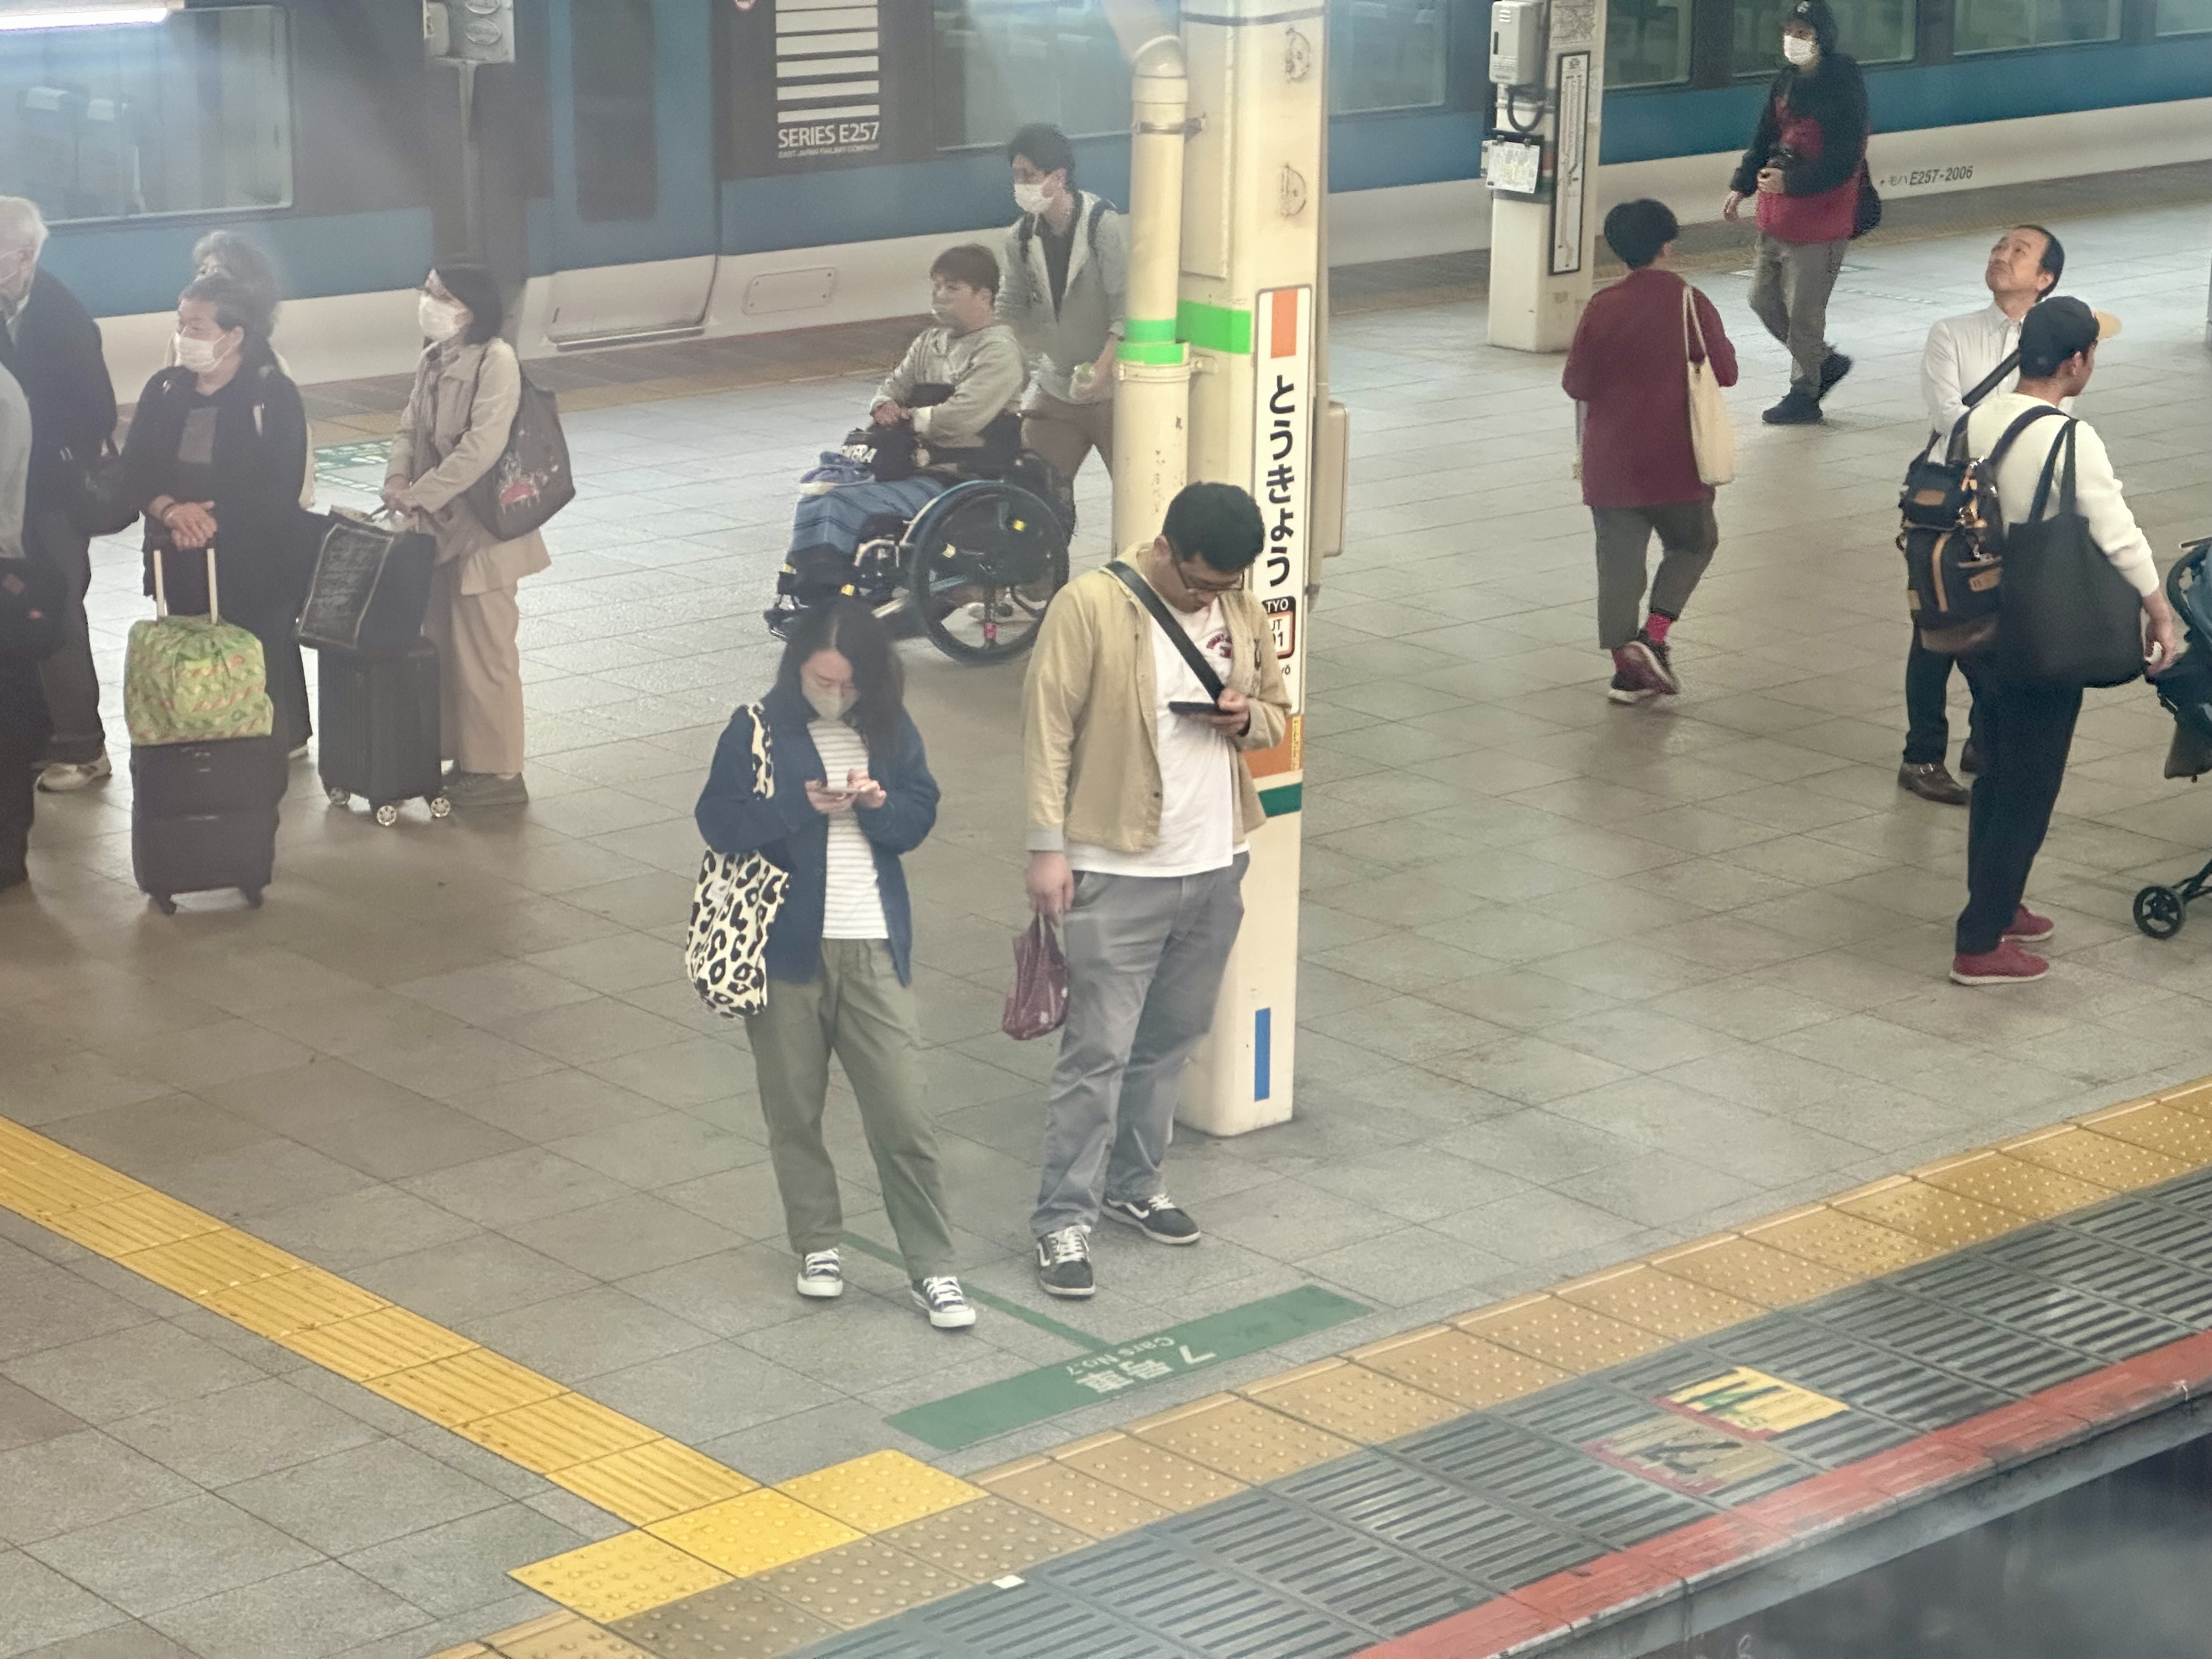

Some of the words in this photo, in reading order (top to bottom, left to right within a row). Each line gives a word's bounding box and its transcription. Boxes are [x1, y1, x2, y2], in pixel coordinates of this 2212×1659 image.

[778, 125, 836, 148] SERIES
[839, 122, 880, 143] E257
[1266, 375, 1295, 587] とうきょう
[1266, 597, 1289, 613] TYO
